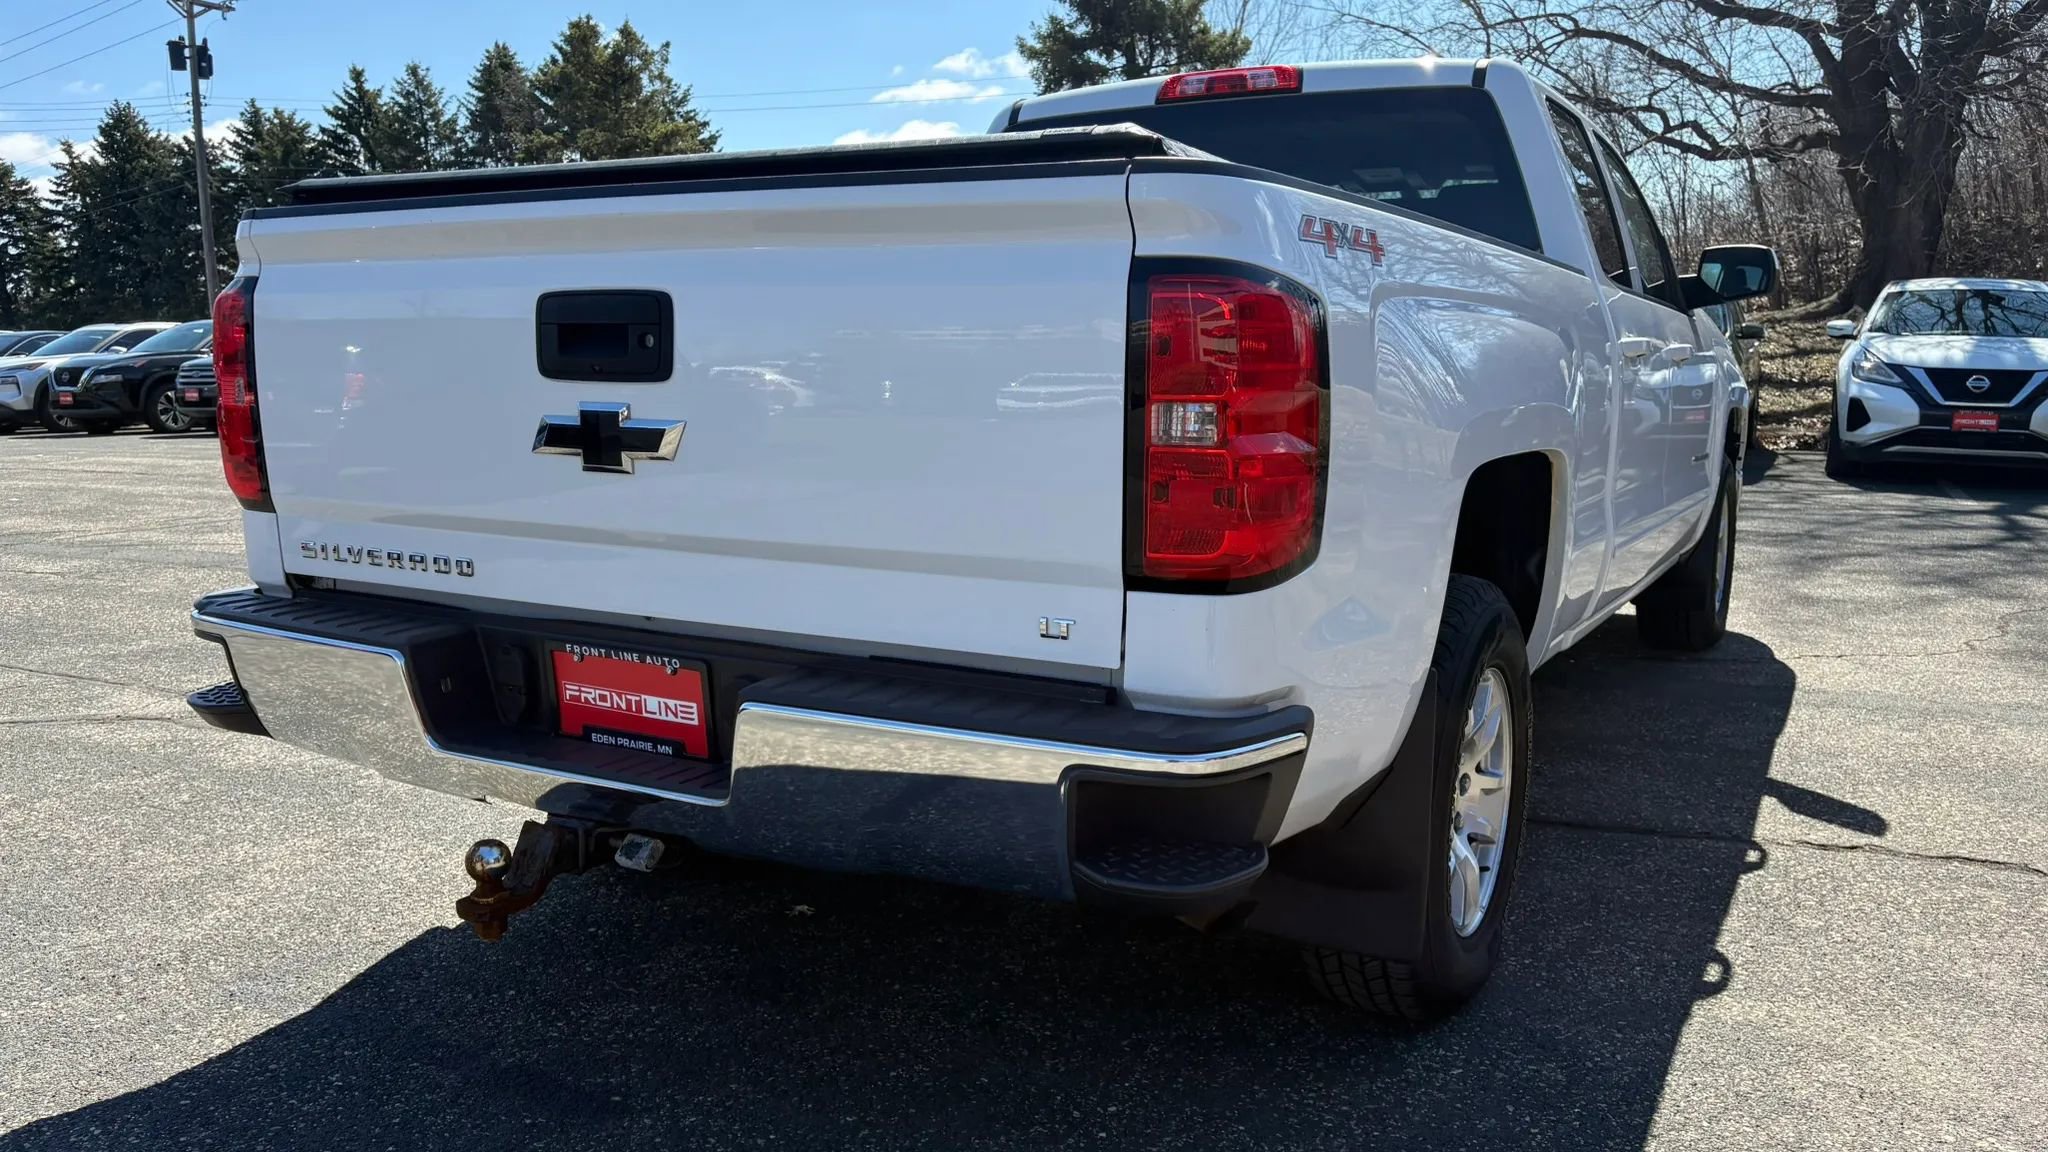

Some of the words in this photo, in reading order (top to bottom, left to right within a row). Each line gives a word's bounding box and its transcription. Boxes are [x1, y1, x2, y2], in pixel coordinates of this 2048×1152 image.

[301, 540, 476, 577] SILVERADO
[1040, 616, 1076, 640] LT
[565, 643, 606, 658] FRONT
[611, 650, 641, 663] LINE
[645, 655, 680, 669] AUTO
[591, 733, 616, 745] EDEN
[617, 737, 656, 753] PRAIRIE,
[657, 744, 673, 755] MN
